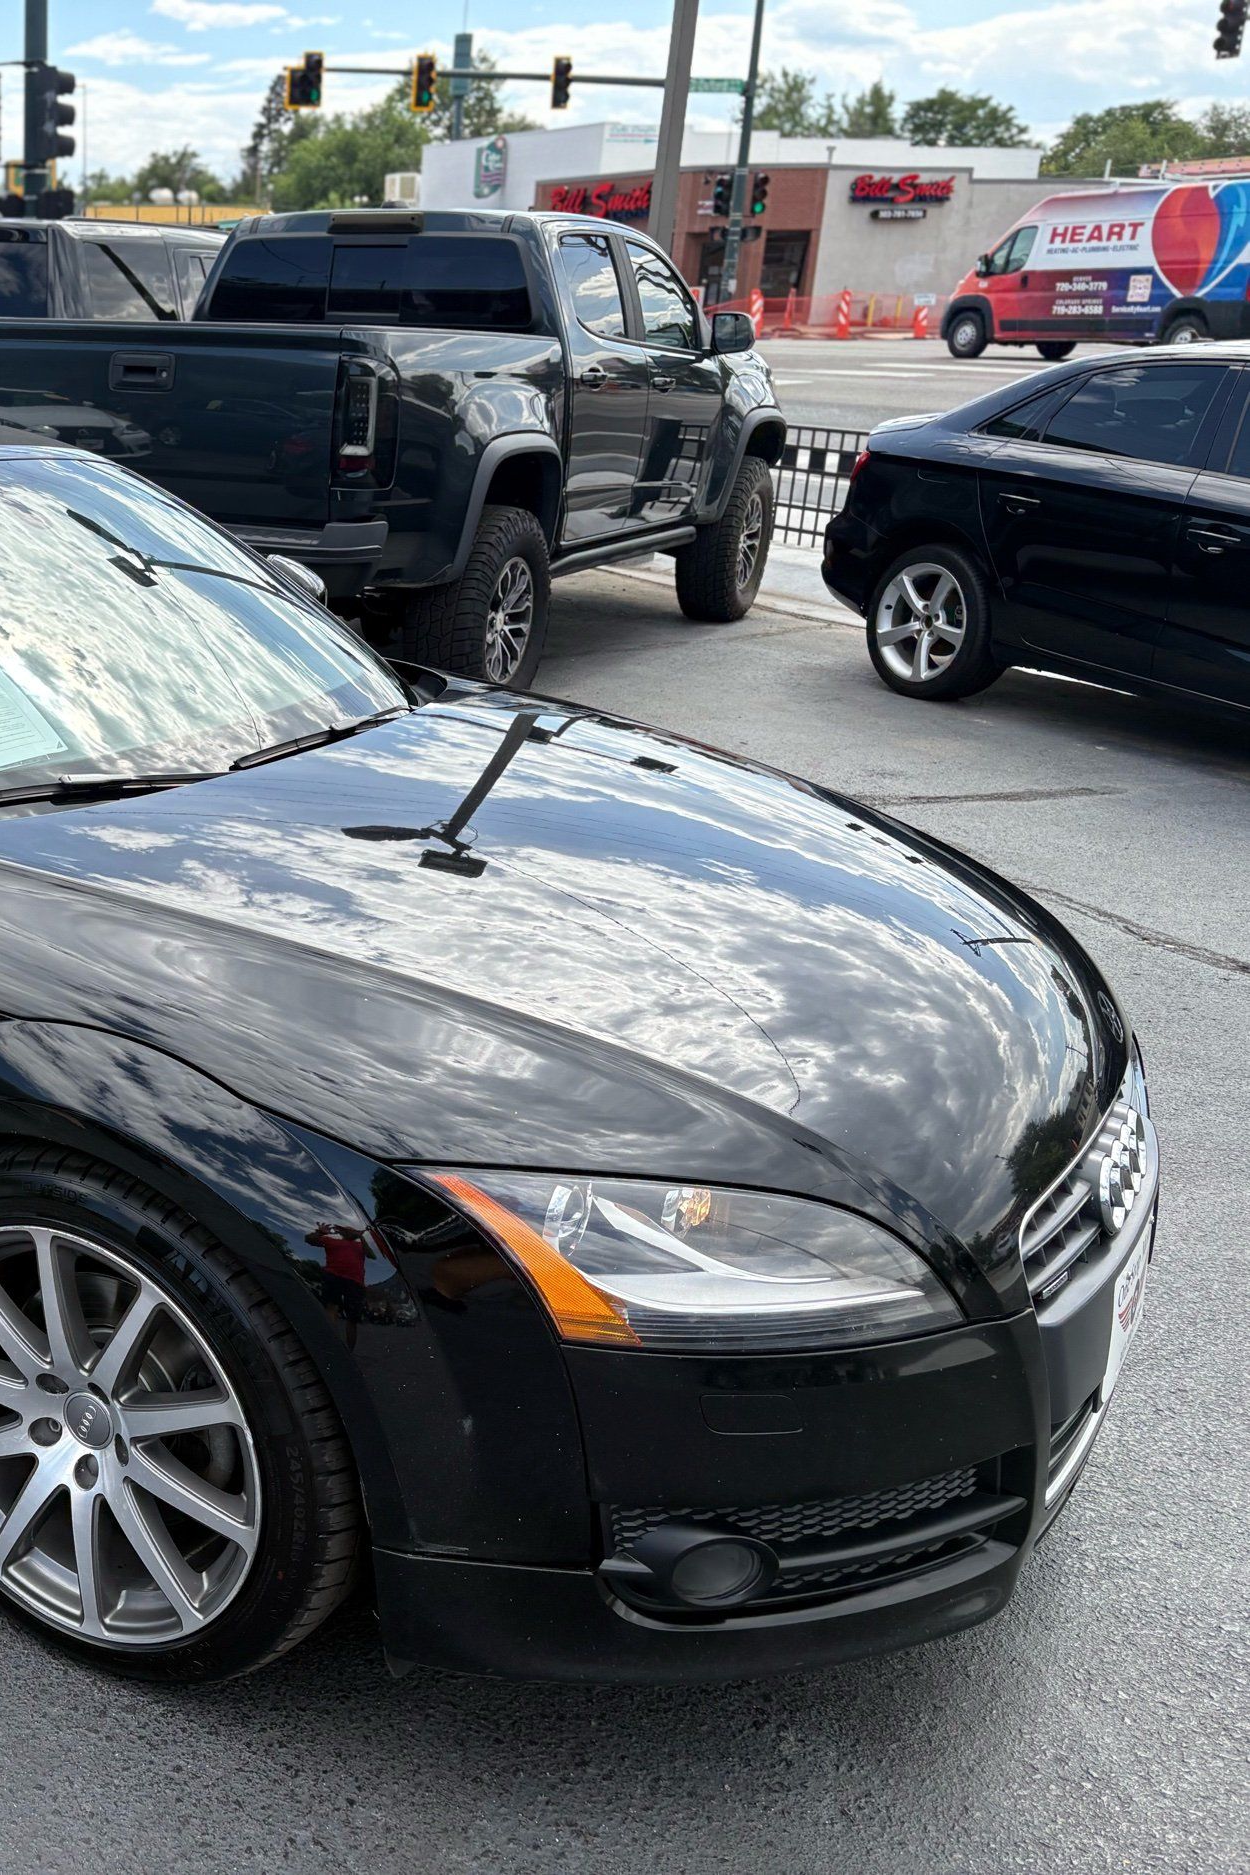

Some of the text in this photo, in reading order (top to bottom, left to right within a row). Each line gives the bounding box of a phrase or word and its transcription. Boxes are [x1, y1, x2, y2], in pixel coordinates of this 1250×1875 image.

[550, 184, 587, 212] Bill
[589, 178, 654, 218] Smith
[854, 173, 956, 203] Bill Smith
[1049, 222, 1145, 244] HEART
